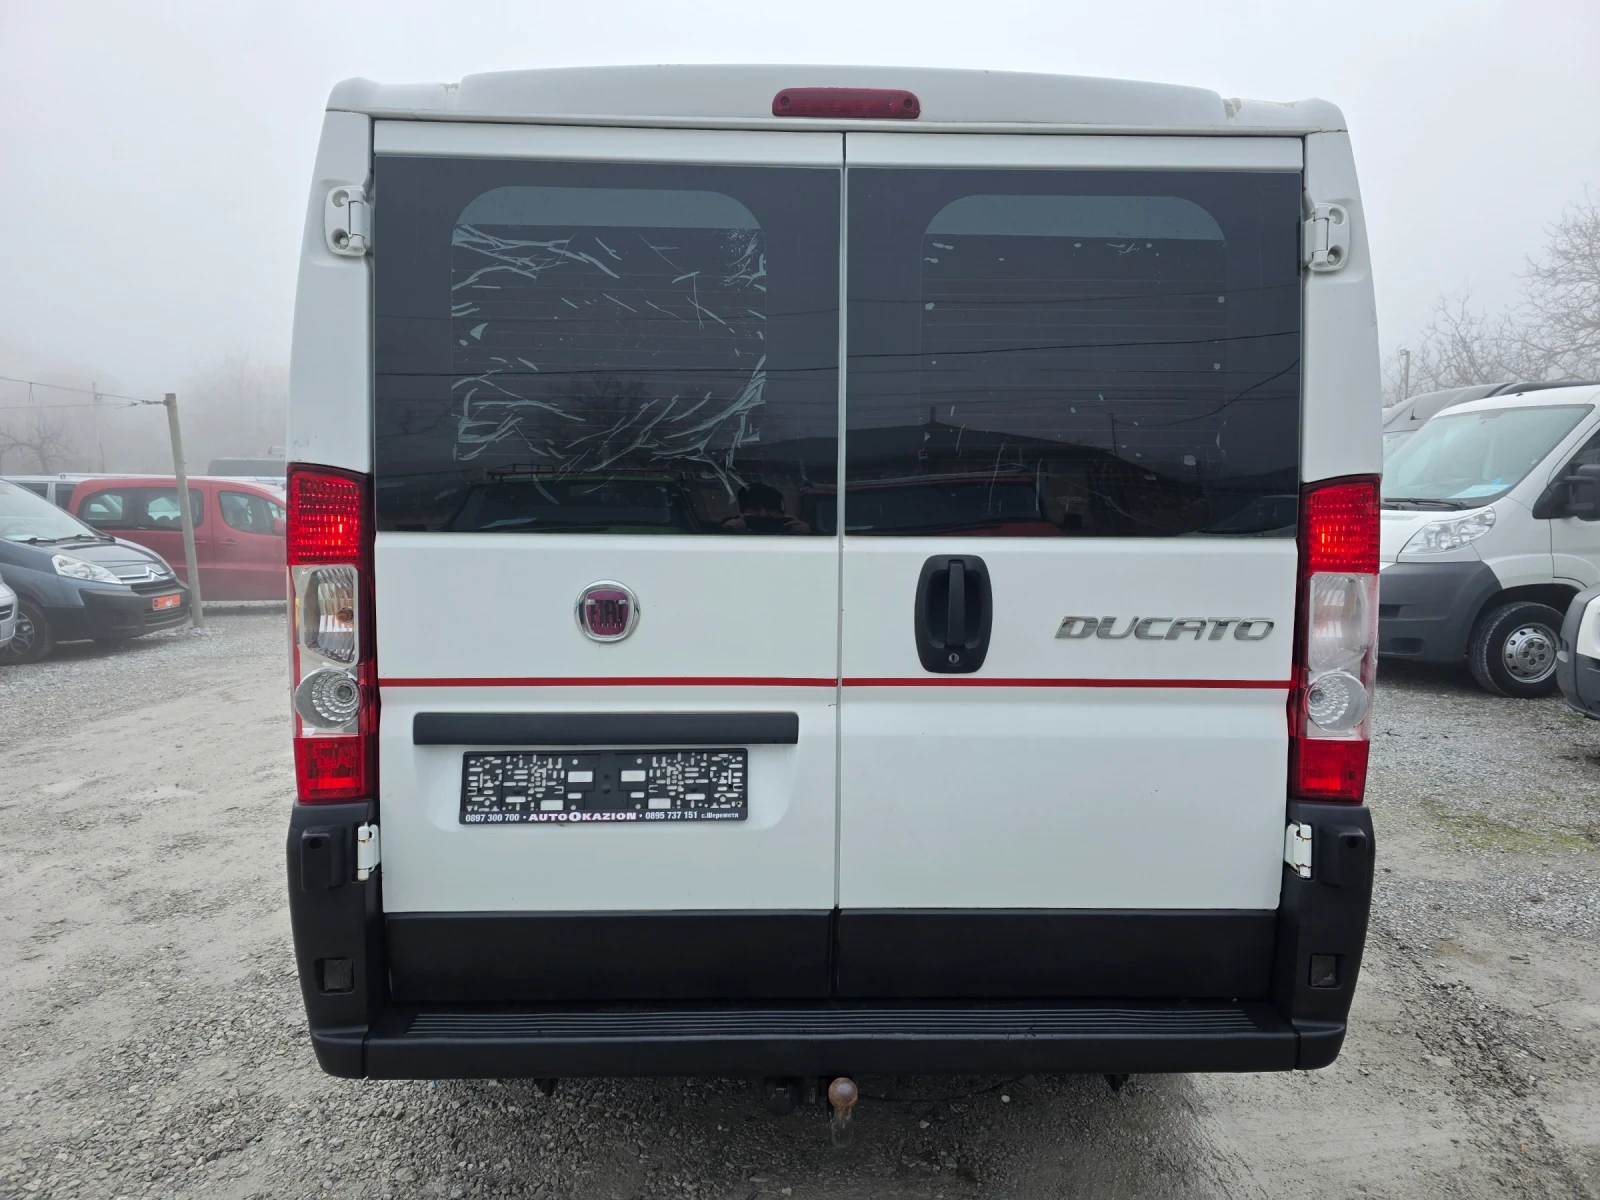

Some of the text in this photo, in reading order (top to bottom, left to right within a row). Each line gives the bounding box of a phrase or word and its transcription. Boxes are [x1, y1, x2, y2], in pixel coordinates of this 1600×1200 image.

[1055, 616, 1275, 641] DUCATO
[465, 813, 485, 822] 0897
[487, 813, 502, 822] 300
[504, 813, 519, 822] 700
[645, 811, 665, 820] 0895
[667, 811, 681, 819] 737
[684, 811, 698, 819] 151
